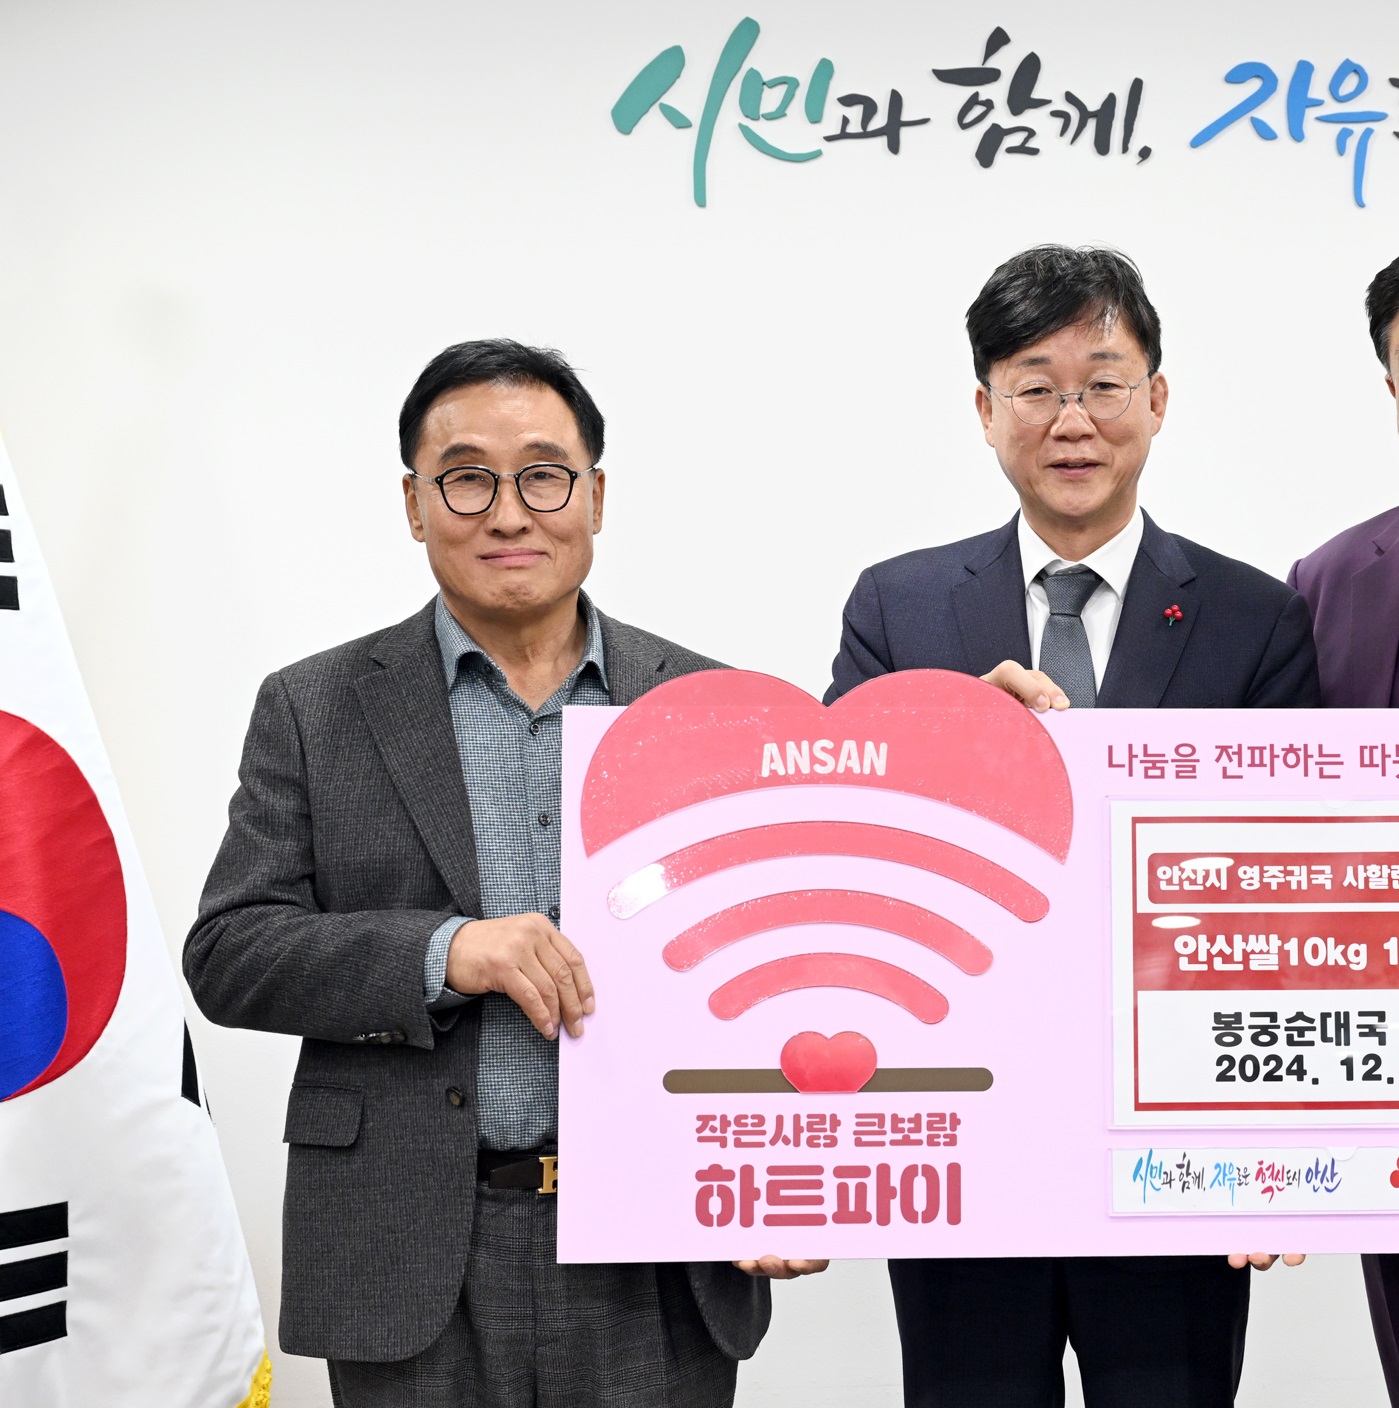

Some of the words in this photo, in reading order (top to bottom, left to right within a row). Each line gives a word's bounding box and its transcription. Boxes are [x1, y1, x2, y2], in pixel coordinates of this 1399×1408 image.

[611, 16, 930, 207] 시민과
[931, 26, 1152, 169] 함께,
[761, 738, 889, 778] ANSAN
[1106, 743, 1200, 779] 나눔을
[1214, 743, 1344, 779] 전파하는
[1156, 863, 1229, 892] 안산시
[1237, 863, 1333, 891] 영주귀국
[1173, 933, 1369, 972] 안산쌀10kg
[1212, 1010, 1388, 1048] 봉궁순대국
[1214, 1053, 1320, 1086] 2024.
[1339, 1053, 1395, 1085] 12.
[695, 1112, 842, 1149] 작은사랑
[852, 1111, 962, 1148] 큰보람
[695, 1161, 962, 1228] 하트파이
[1132, 1148, 1175, 1204] 시민과
[1175, 1151, 1206, 1193] 함께,
[1209, 1162, 1250, 1206] 자유로운
[1255, 1160, 1301, 1203] 혁신도시
[1305, 1157, 1342, 1193] 안산
